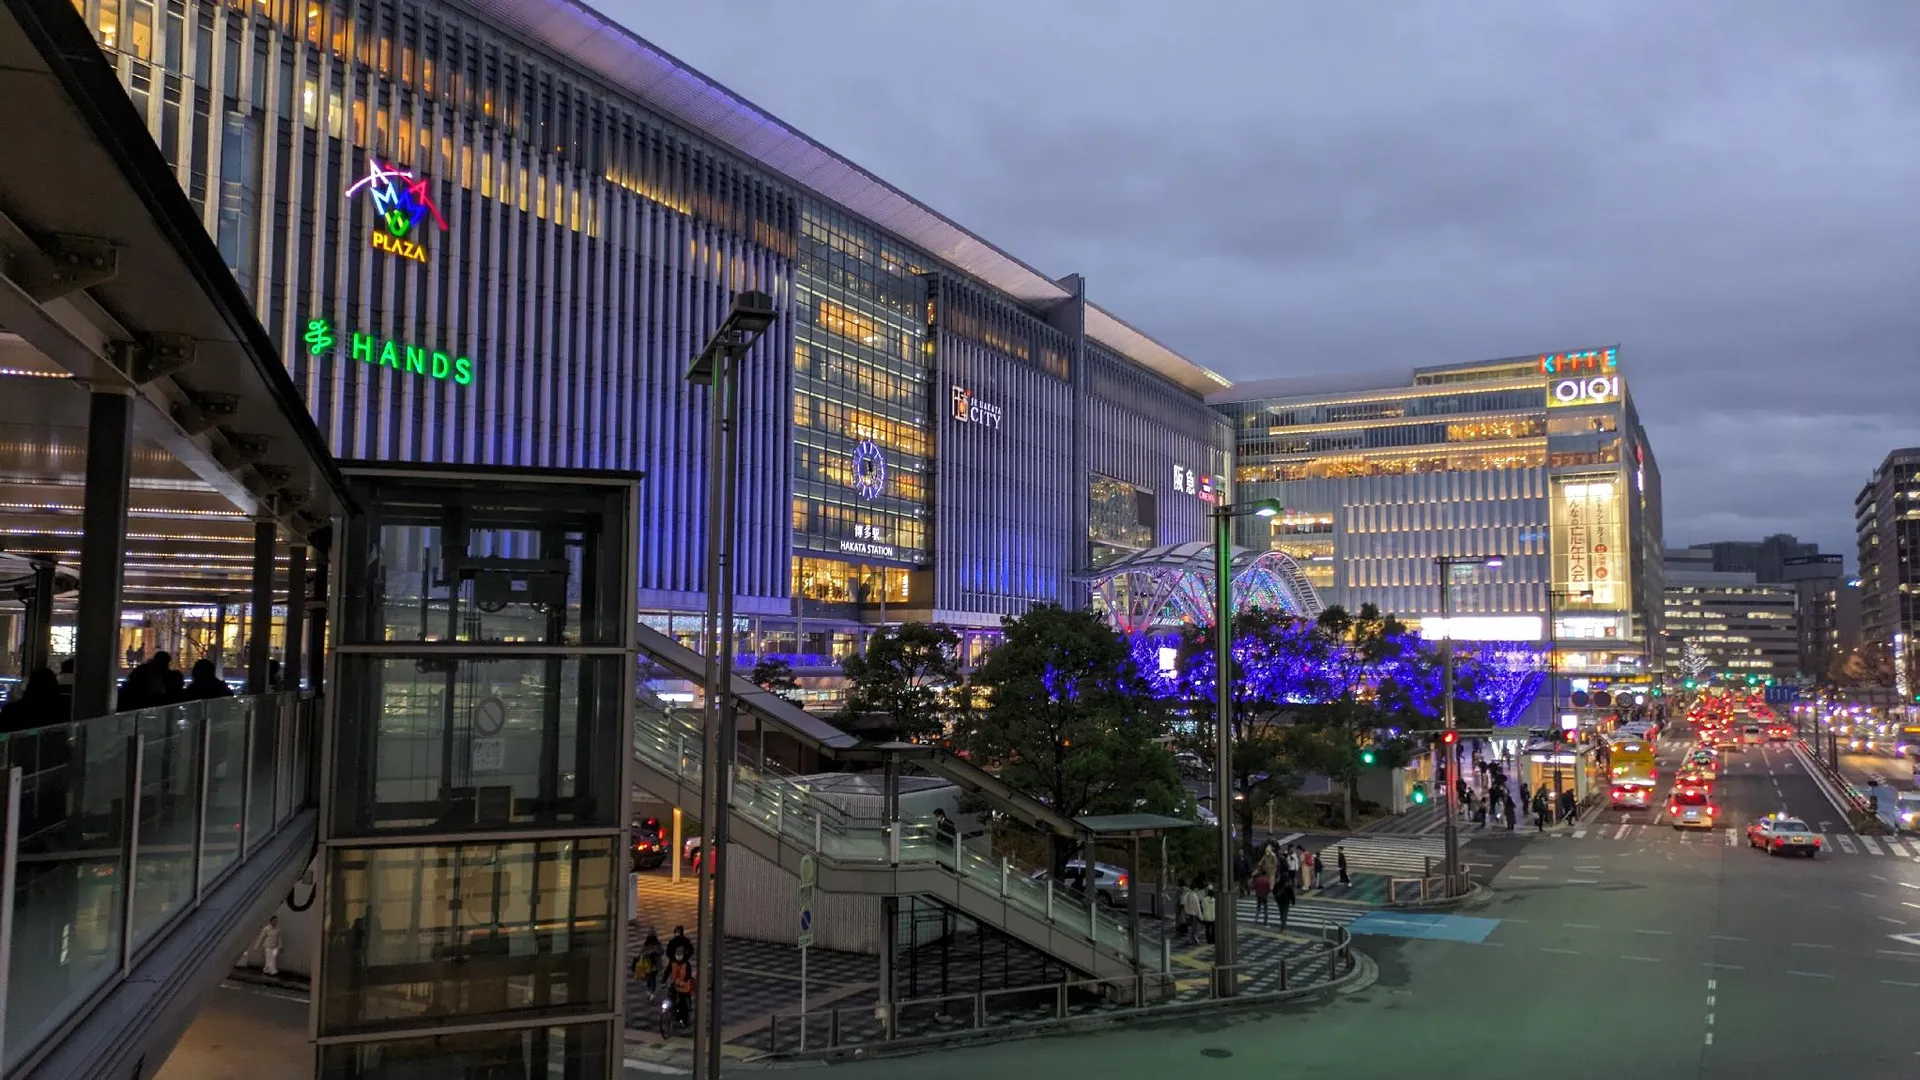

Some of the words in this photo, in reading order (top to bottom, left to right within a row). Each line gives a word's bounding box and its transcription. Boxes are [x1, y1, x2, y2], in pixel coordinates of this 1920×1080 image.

[373, 231, 426, 263] PLAZA
[352, 332, 472, 385] HANDS
[1540, 348, 1617, 373] KITTE
[971, 406, 1001, 429] CITY
[1173, 464, 1195, 495] 阪急
[854, 524, 880, 540] 博多駅
[840, 540, 866, 553] HAKATA
[867, 545, 893, 557] STATION
